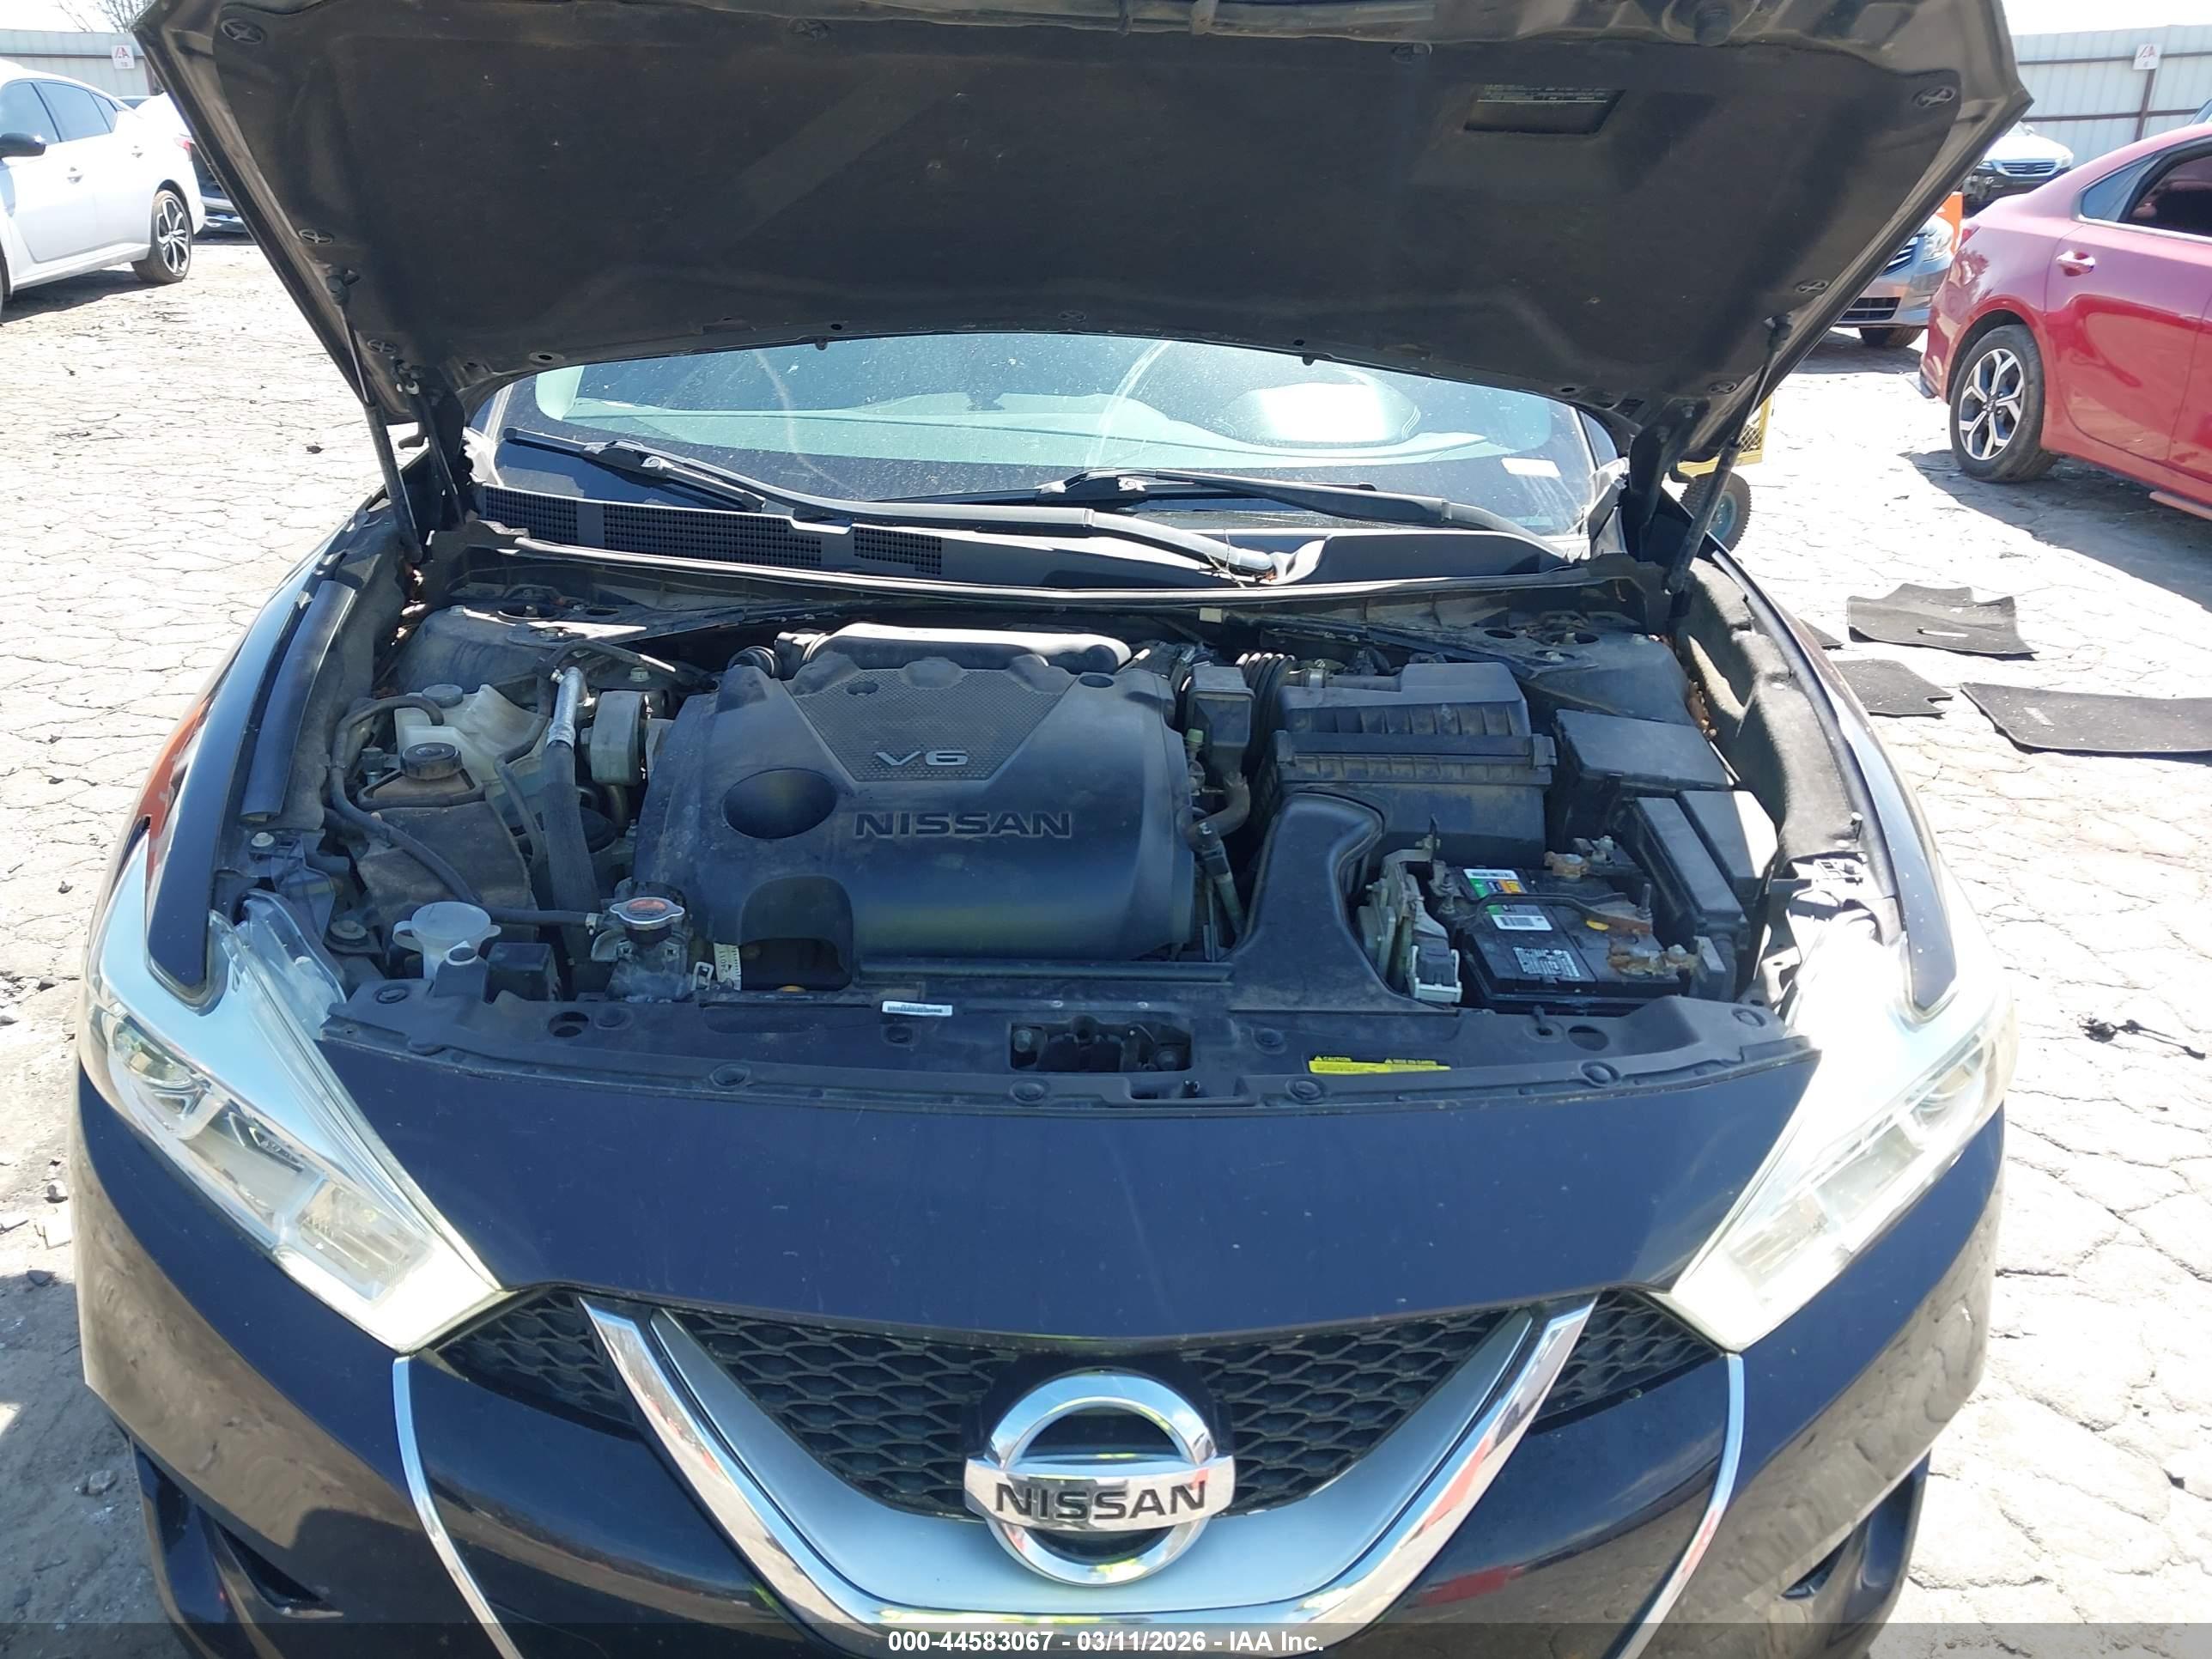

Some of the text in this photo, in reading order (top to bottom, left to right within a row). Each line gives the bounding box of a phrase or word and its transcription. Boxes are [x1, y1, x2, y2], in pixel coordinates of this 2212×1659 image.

[875, 750, 969, 766] V6
[854, 811, 1072, 839] NISSAN
[994, 1480, 1206, 1521] NISSAN
